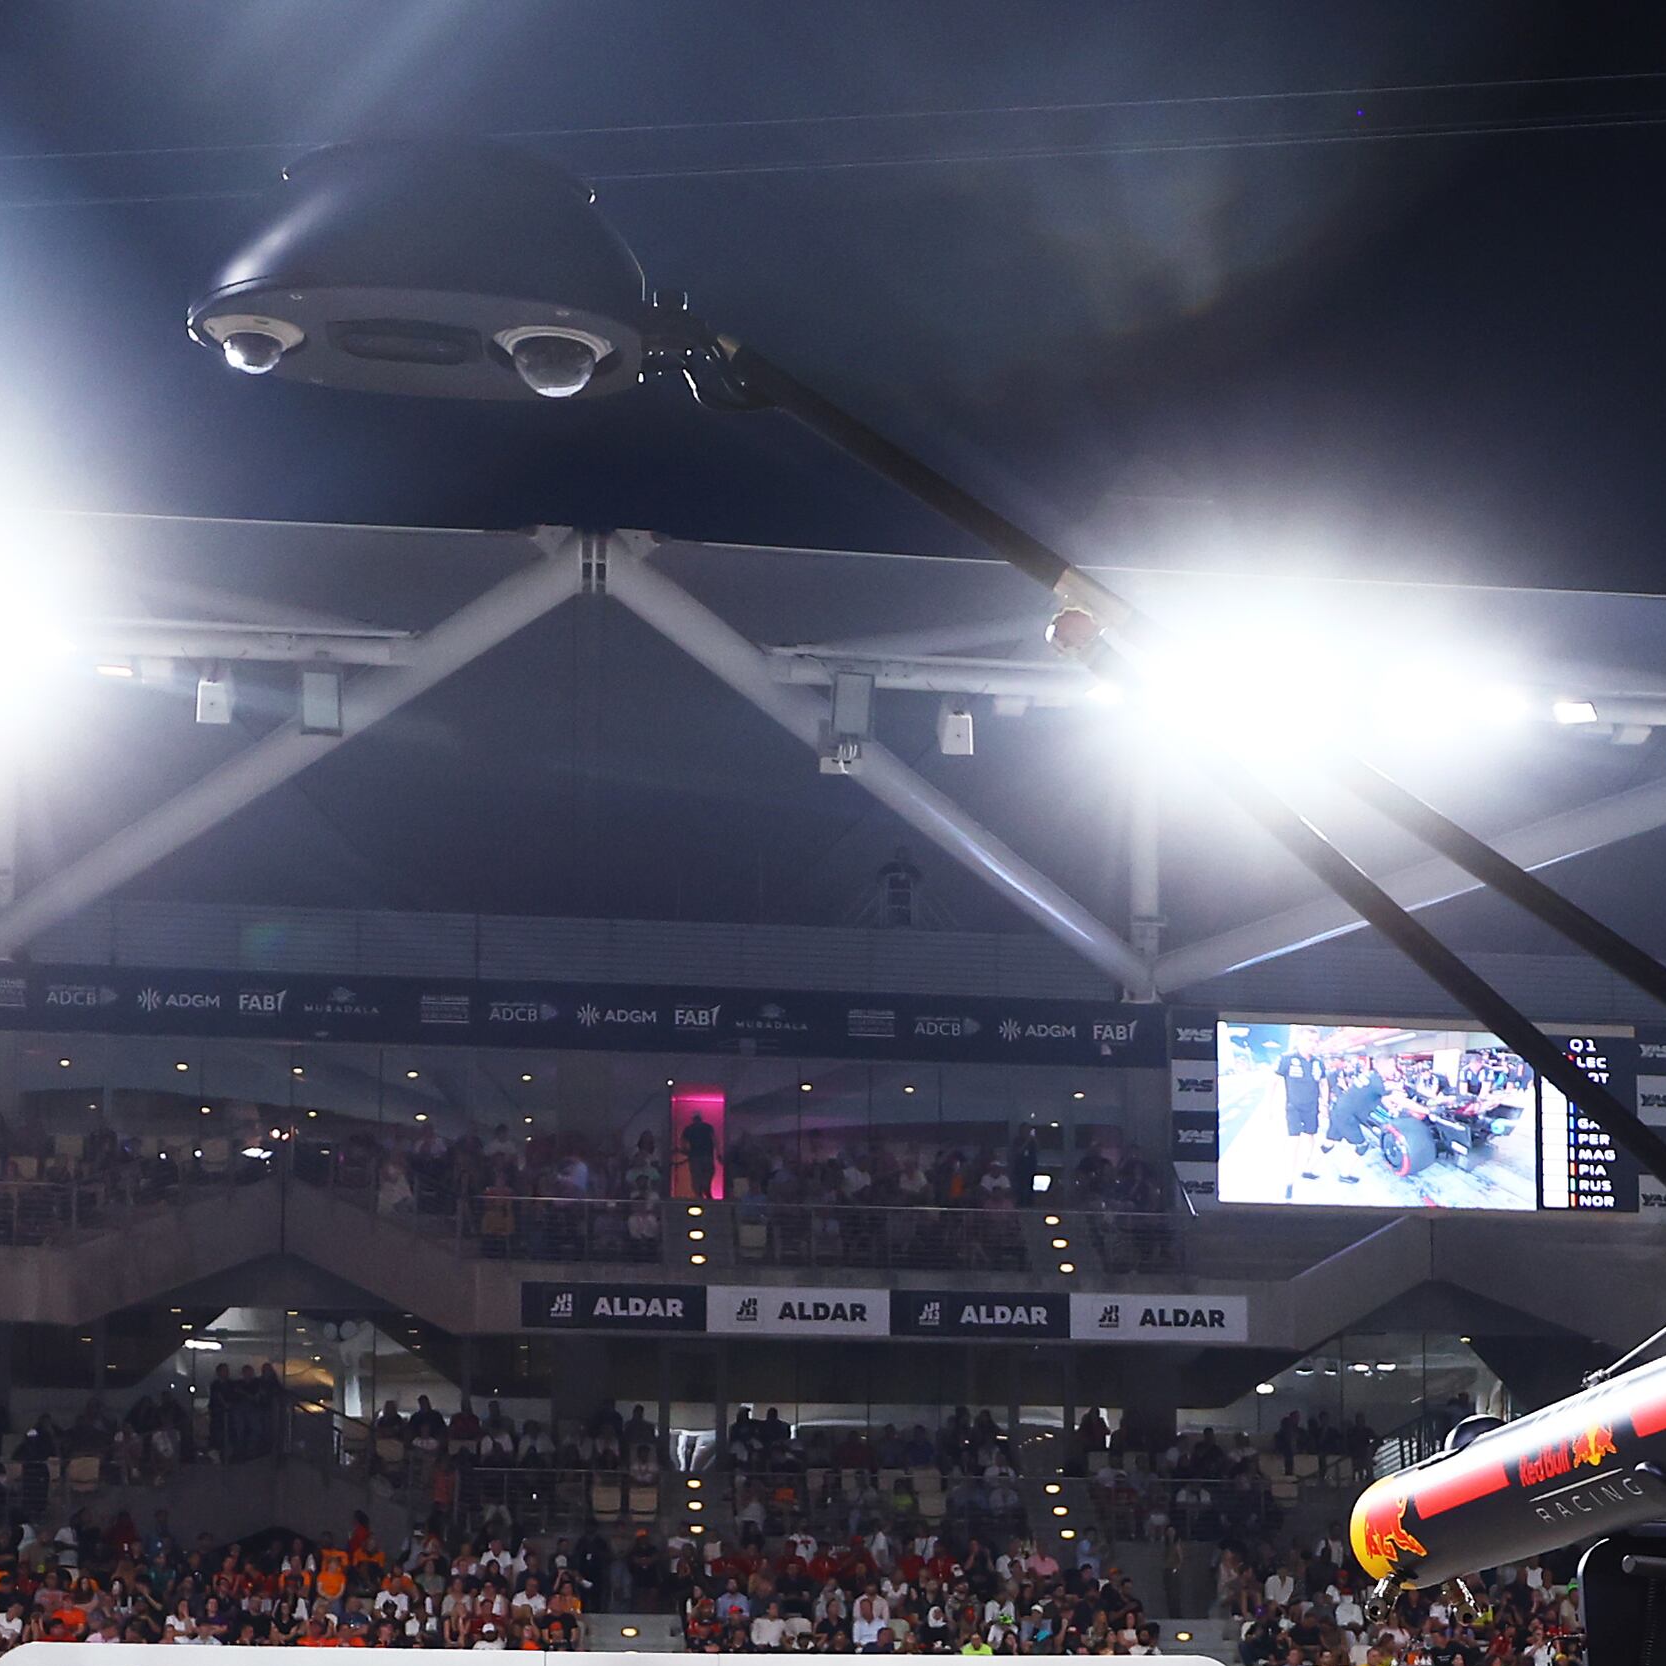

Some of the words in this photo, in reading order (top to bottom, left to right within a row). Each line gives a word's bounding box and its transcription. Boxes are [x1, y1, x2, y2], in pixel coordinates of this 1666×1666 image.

[46, 991, 97, 1006] ADCB
[165, 994, 220, 1009] ADGM
[239, 994, 276, 1011] FAB
[489, 1006, 538, 1021] ADCB
[604, 1010, 657, 1023] ADGM
[675, 1009, 711, 1026] FAB
[914, 1022, 961, 1036] ADCB
[1024, 1026, 1076, 1038] ADGM
[1093, 1025, 1130, 1041] FAB
[1569, 1039, 1597, 1053] Q1
[1576, 1057, 1607, 1069] LEC
[1578, 1133, 1610, 1146] PER
[1578, 1149, 1616, 1161] MAG
[1579, 1164, 1607, 1177] PIA
[1579, 1179, 1612, 1192] RUS
[1579, 1195, 1615, 1208] NOR
[592, 1296, 685, 1317] ALDAR
[777, 1301, 867, 1322] ALDAR
[959, 1305, 1048, 1325] ALDAR
[1139, 1308, 1226, 1328] ALDAR
[1535, 1478, 1643, 1524] RACING
